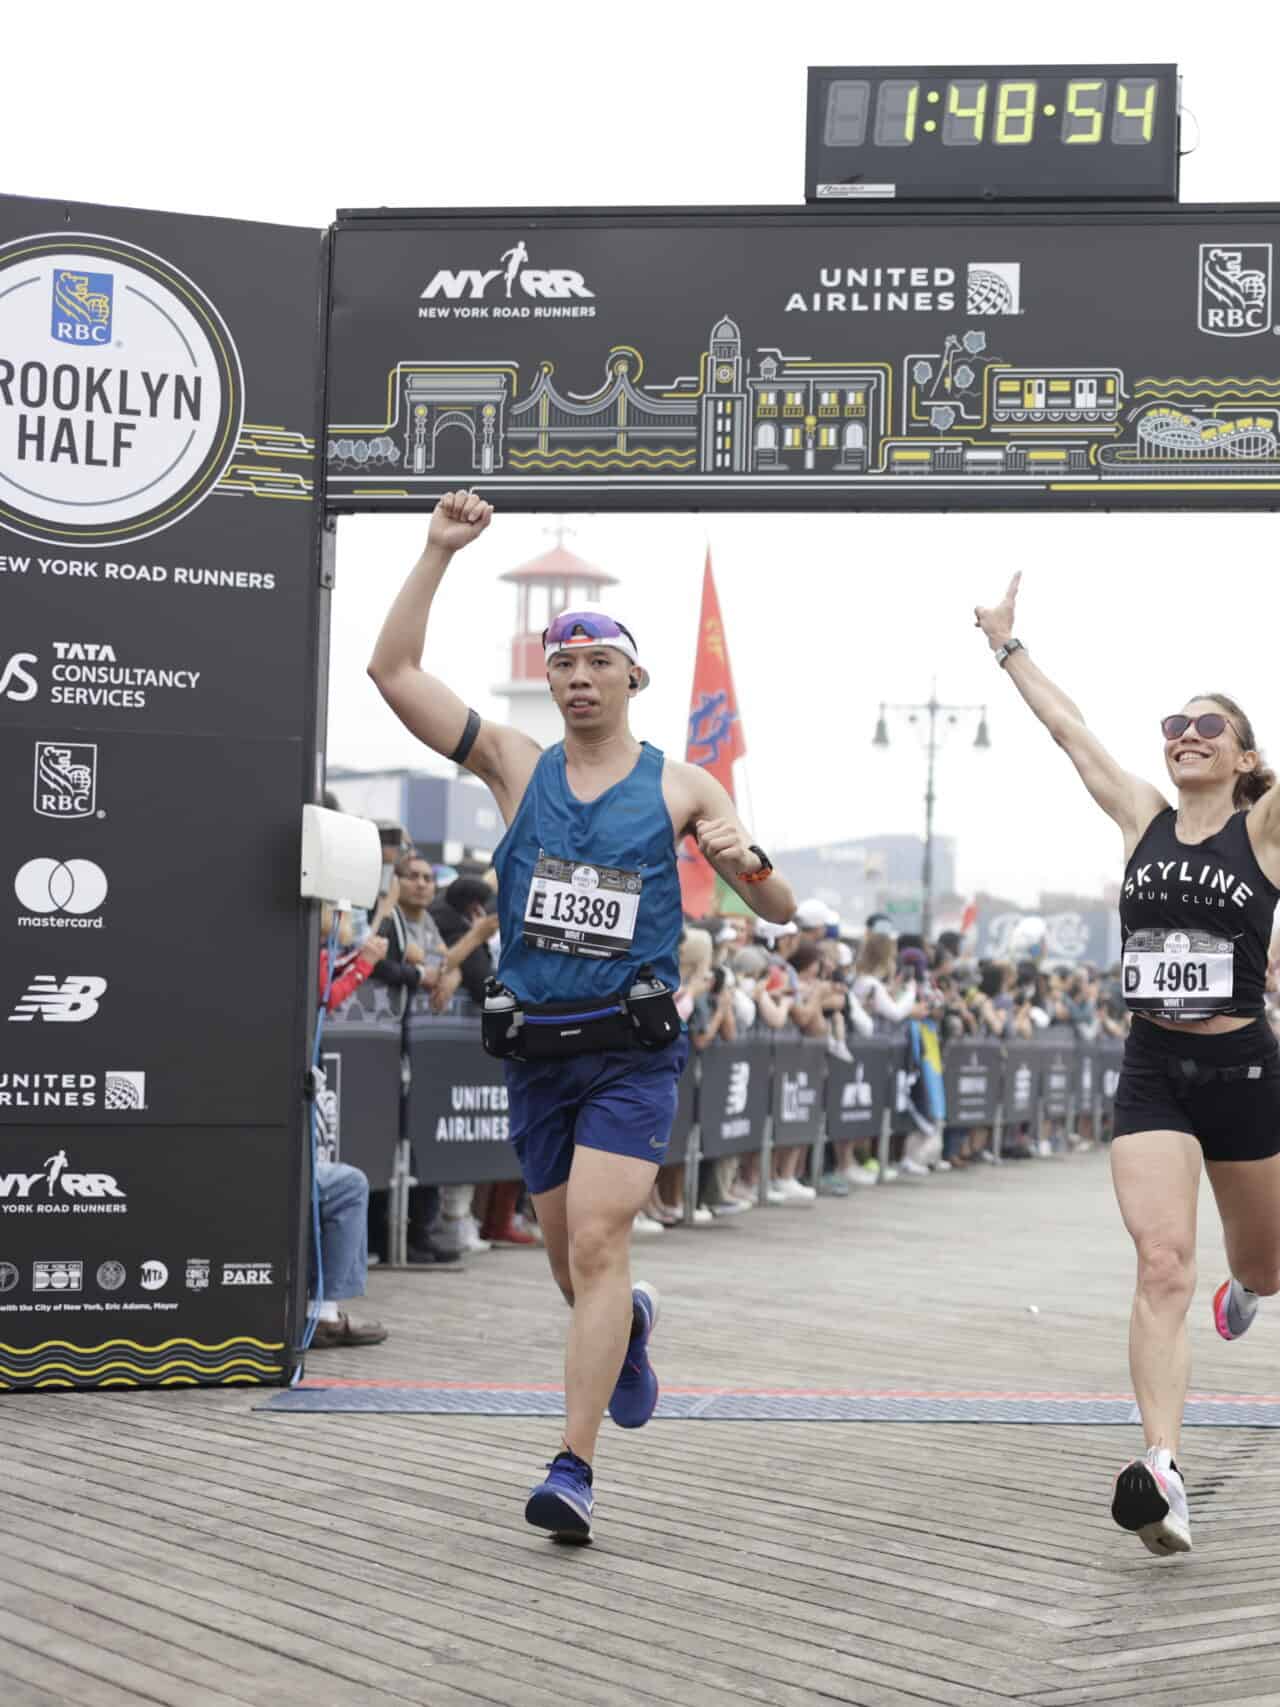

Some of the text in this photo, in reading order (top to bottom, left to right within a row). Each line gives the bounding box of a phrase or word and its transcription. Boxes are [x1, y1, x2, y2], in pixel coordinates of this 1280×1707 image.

[820, 268, 955, 287] UNITED
[418, 306, 596, 318] NEW YORK ROAD RUNNERS
[785, 292, 954, 312] AIRLINES
[1207, 308, 1263, 328] RBC
[57, 321, 106, 342] RBC
[0, 358, 202, 421] ROOKLYN
[17, 414, 137, 468] HALF
[37, 558, 98, 577] YORK
[105, 564, 167, 582] ROAD
[173, 568, 276, 590] RUNNERS
[53, 642, 116, 662] TATA
[52, 664, 200, 689] CONSULTANCY
[51, 686, 146, 708] SERVICES
[41, 795, 88, 812] RBC
[1125, 861, 1254, 908] SKYLINE
[1139, 891, 1225, 908] RUN CLUB
[529, 891, 621, 930] E 13389
[17, 915, 104, 929] mastercard
[1125, 962, 1210, 992] D 4961
[451, 1086, 508, 1110] UNITED
[436, 1116, 509, 1141] AIRLINES
[2, 1203, 127, 1213] YORK ROAD RUNNERS
[223, 1270, 272, 1283] PARK
[35, 1304, 51, 1312] City
